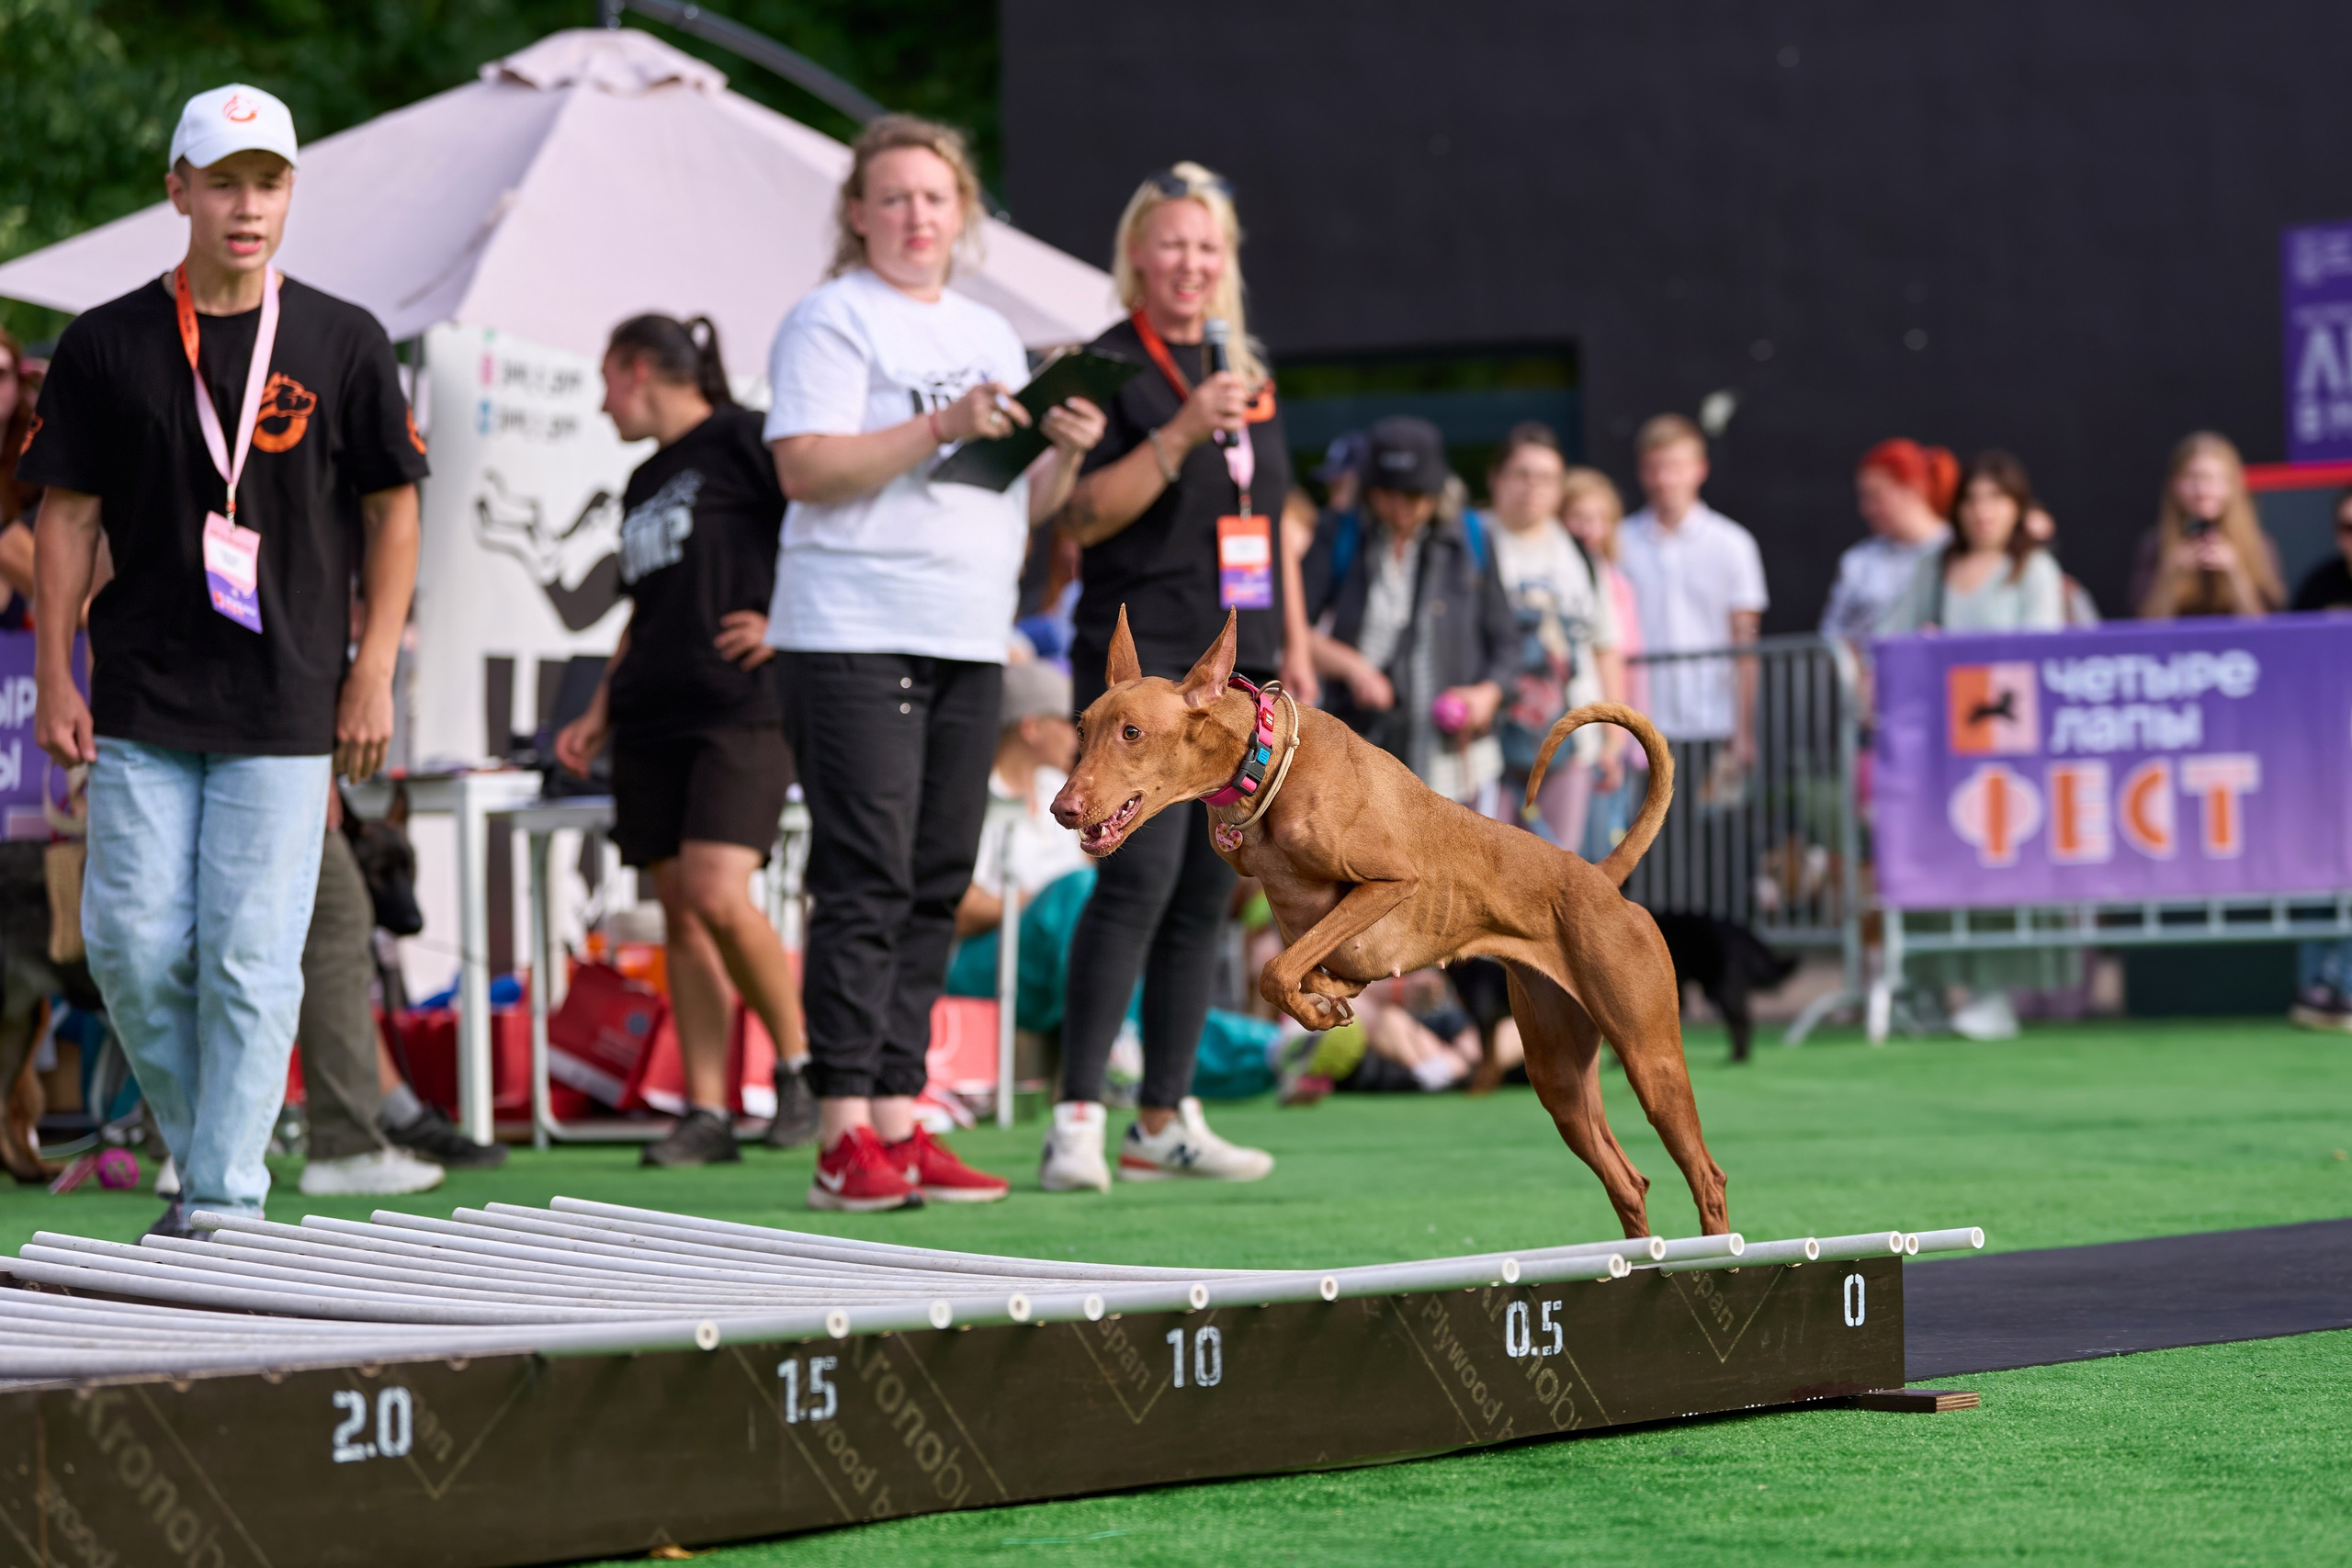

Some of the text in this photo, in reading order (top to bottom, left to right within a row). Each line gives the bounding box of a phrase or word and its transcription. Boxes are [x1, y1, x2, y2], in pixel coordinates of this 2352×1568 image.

[1947, 753, 2262, 868] ФЕСТ
[1505, 1300, 1564, 1358] 0.5
[1843, 1273, 1867, 1326] 0
[1420, 1293, 1504, 1426] Plywood
[332, 1385, 414, 1463] 2.0
